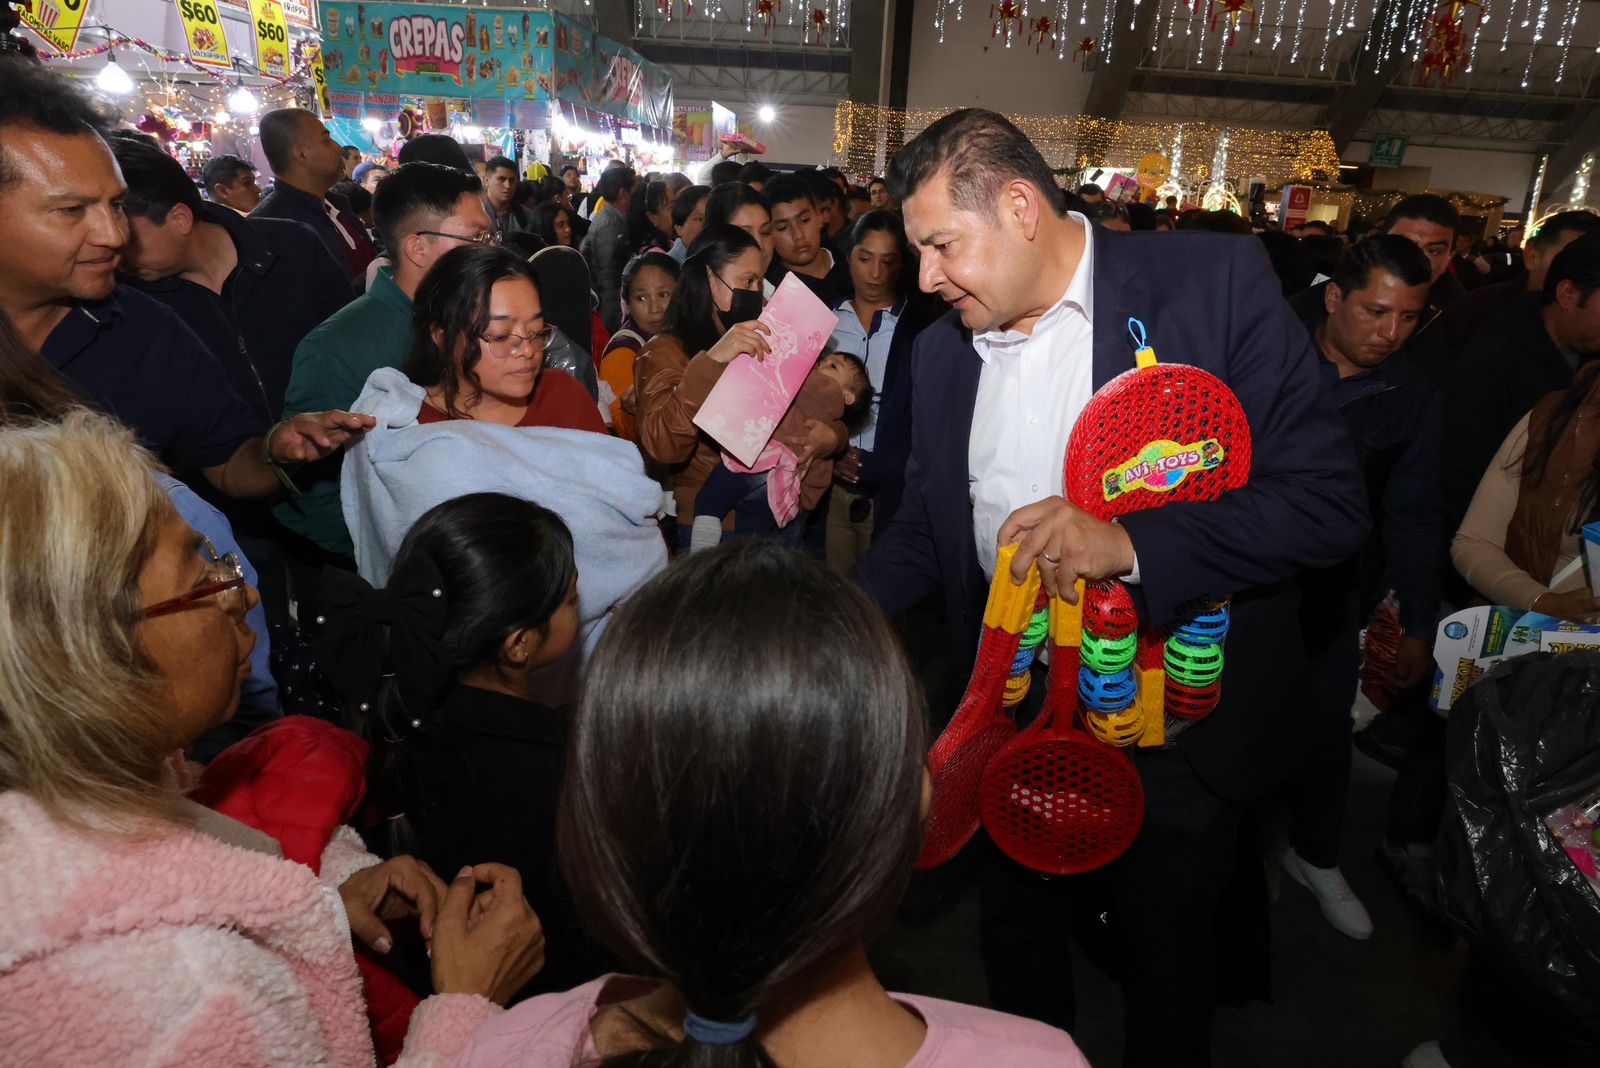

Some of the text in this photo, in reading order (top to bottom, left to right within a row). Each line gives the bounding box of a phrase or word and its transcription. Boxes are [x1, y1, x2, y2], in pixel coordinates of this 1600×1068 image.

[180, 0, 217, 25] $60
[257, 18, 285, 42] $60
[389, 15, 466, 64] CREPAS
[53, 34, 70, 52] VASO
